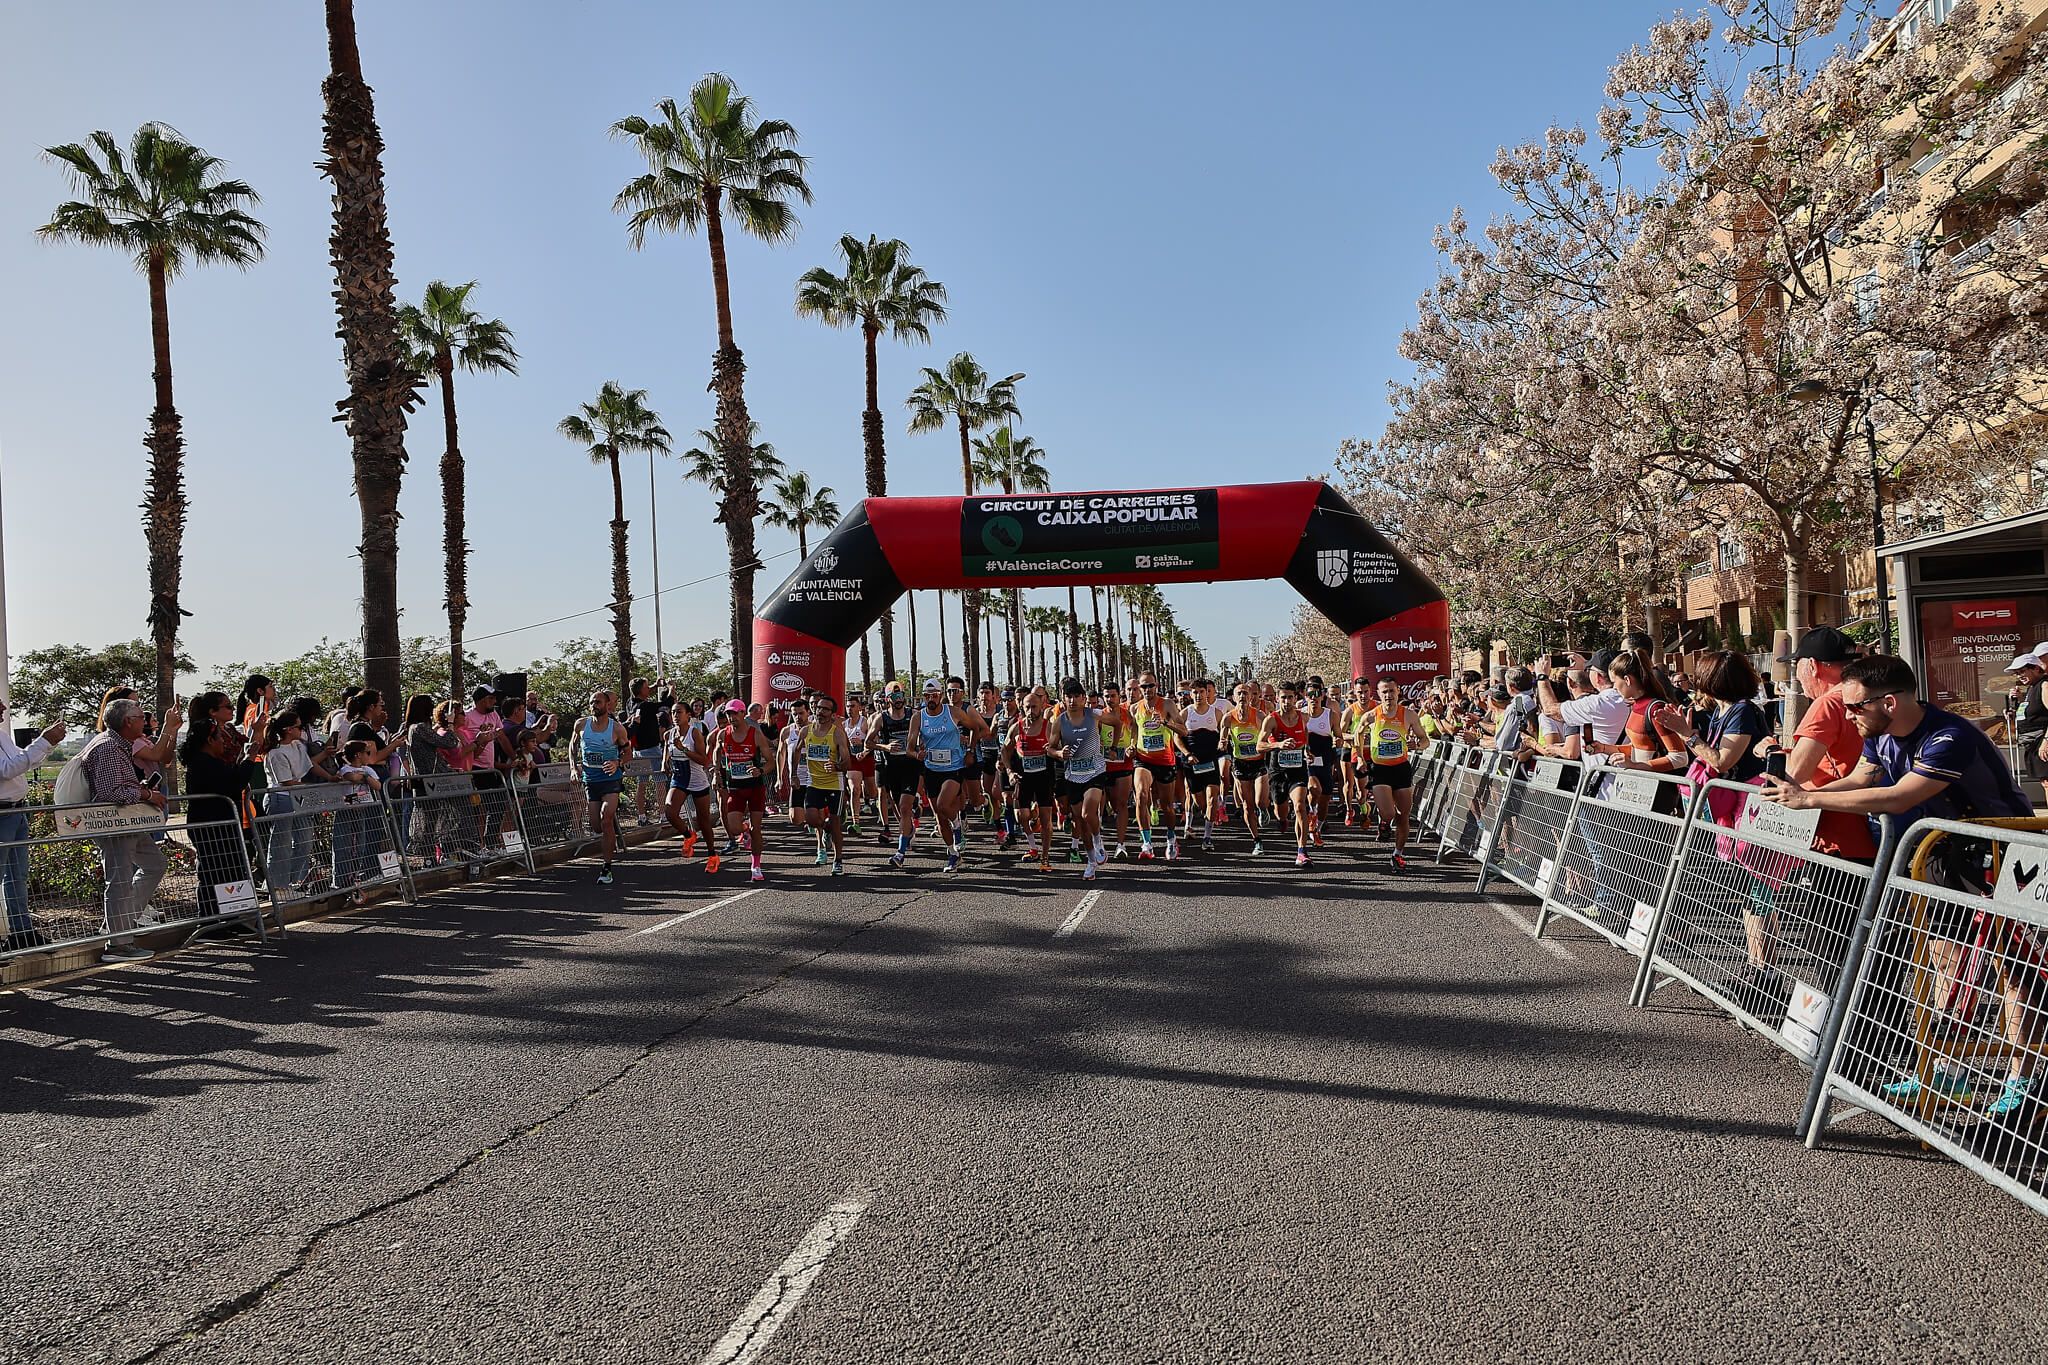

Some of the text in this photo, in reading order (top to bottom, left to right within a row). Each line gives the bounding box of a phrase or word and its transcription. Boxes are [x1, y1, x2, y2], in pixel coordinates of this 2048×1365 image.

[980, 493, 1196, 512] CIRCUIT DE CARRERES
[1104, 524, 1137, 535] CIUTAT
[1138, 524, 1153, 533] DE
[1153, 554, 1180, 562] caixa
[1352, 551, 1394, 560] Fundació
[985, 558, 1103, 571] #ValènciaCorre
[1153, 559, 1194, 568] popular
[1352, 560, 1397, 569] Esportiva
[1352, 568, 1399, 577] Municipal
[1352, 575, 1394, 584] València
[790, 578, 863, 592] AJUNTAMENT
[788, 589, 863, 602] DE VALÈNCIA
[1958, 609, 2012, 619] VIPS
[1952, 633, 2021, 645] REINVENTAMOS
[1959, 643, 2016, 654] los bocatas
[1963, 653, 2014, 663] de SIEMPRE
[1385, 662, 1439, 672] INTERSPORT
[773, 677, 801, 686] Serrano
[82, 809, 120, 820] VALENCIA
[84, 815, 161, 830] CIUDAD DEL RUNNING
